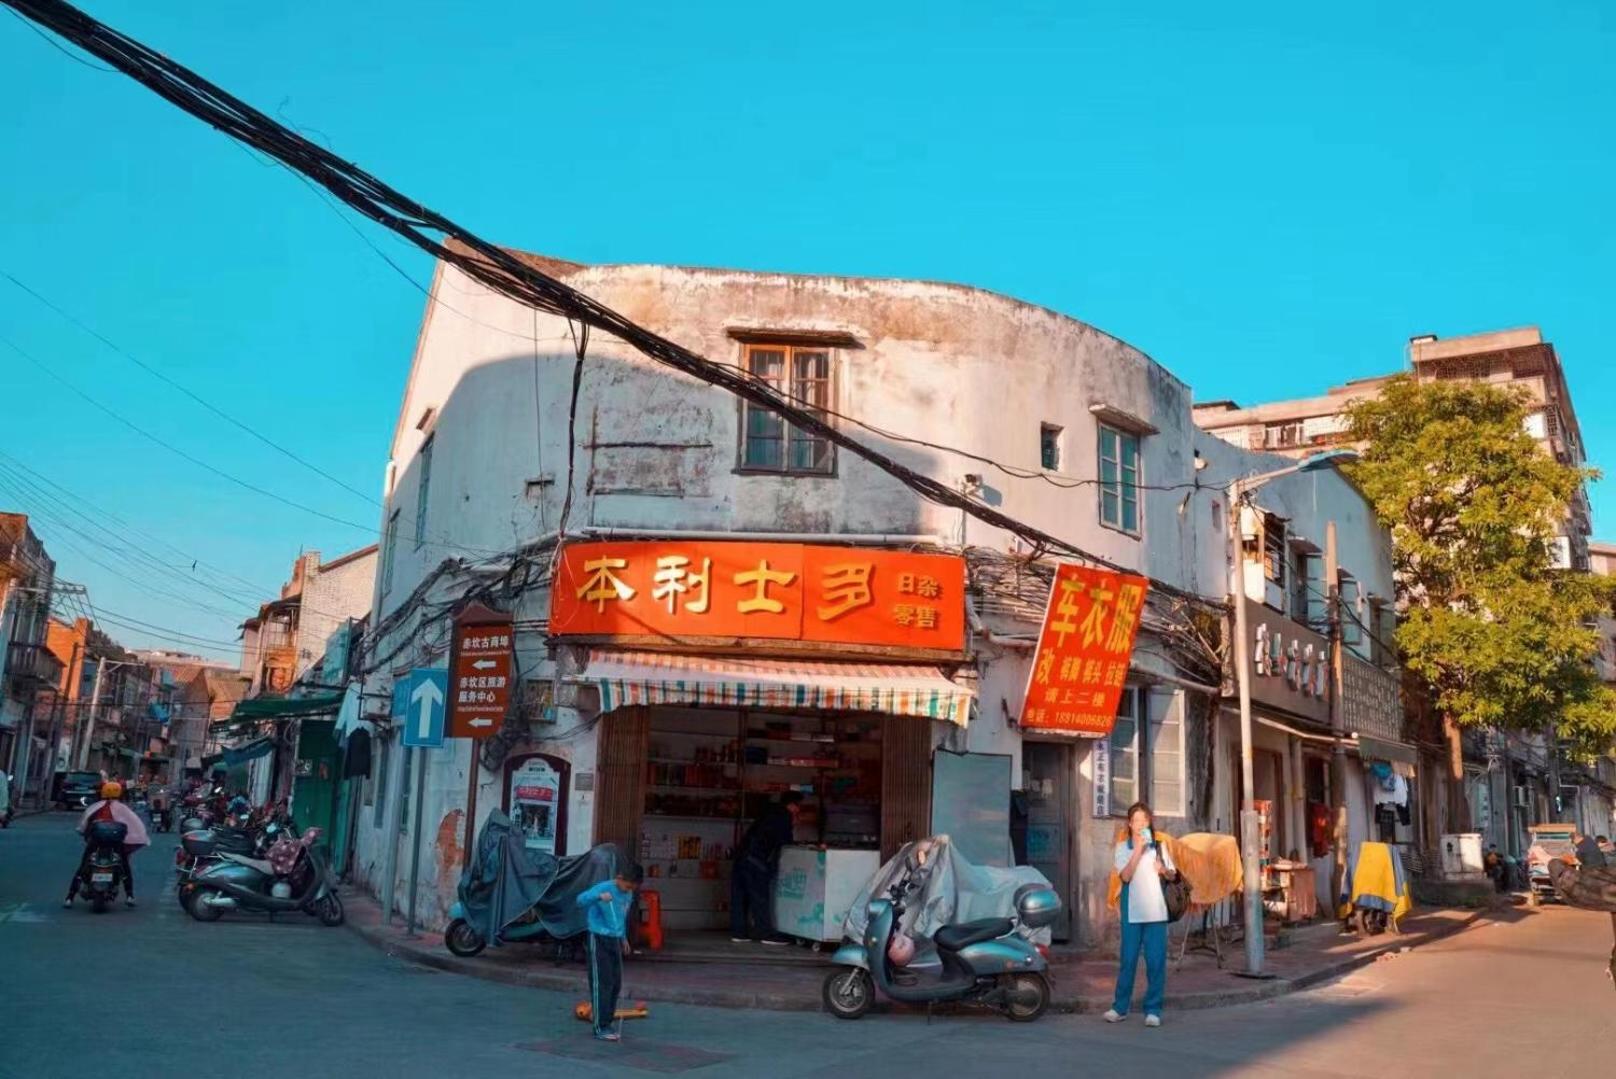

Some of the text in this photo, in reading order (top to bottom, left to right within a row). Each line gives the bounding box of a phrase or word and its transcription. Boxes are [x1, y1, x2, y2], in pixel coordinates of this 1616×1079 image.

[576, 554, 873, 620] 本利士多
[897, 573, 939, 598] 日杂
[893, 604, 936, 628] 零售
[1050, 573, 1143, 654] 车衣服
